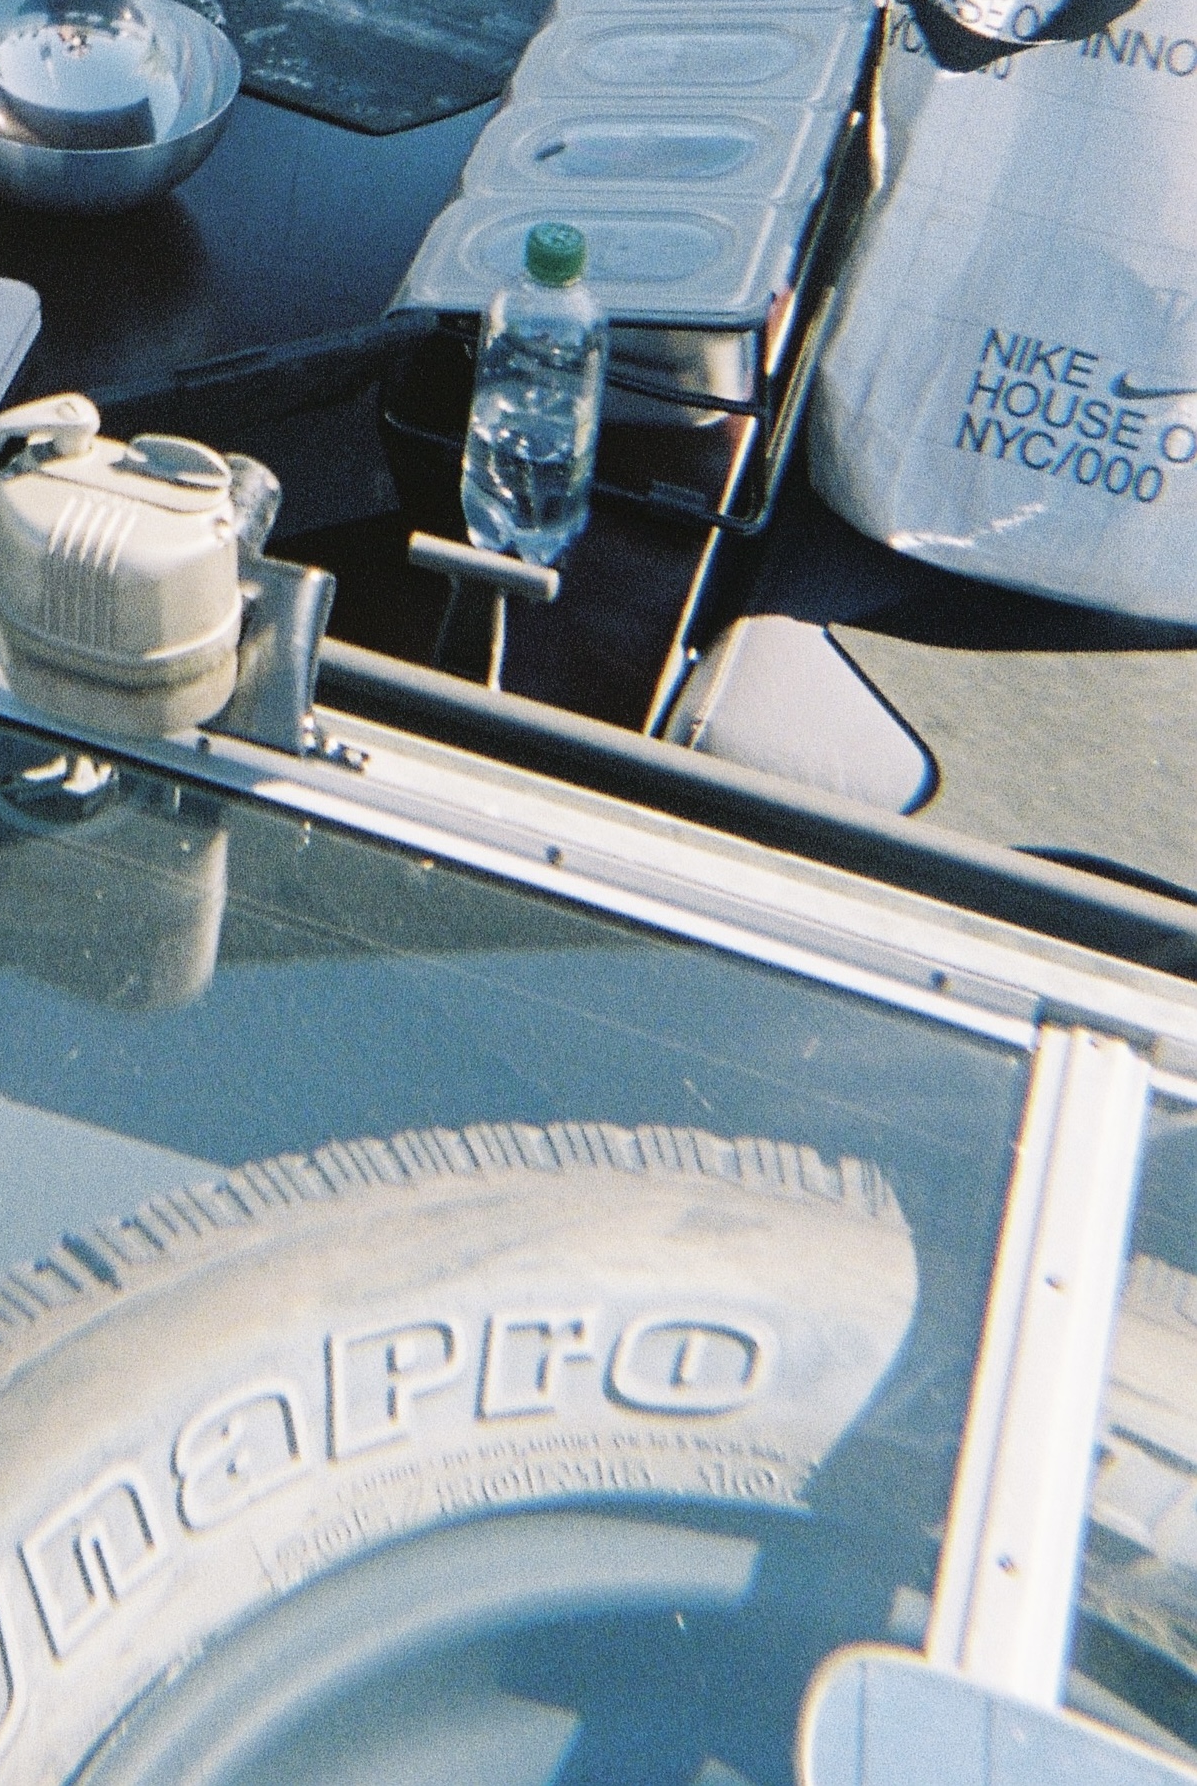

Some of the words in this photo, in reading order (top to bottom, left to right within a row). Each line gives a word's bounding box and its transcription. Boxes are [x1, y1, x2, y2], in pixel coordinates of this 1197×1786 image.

[978, 327, 1100, 390] NIKE
[964, 369, 1148, 452] HOUSE
[953, 411, 1165, 503] NYC/000
